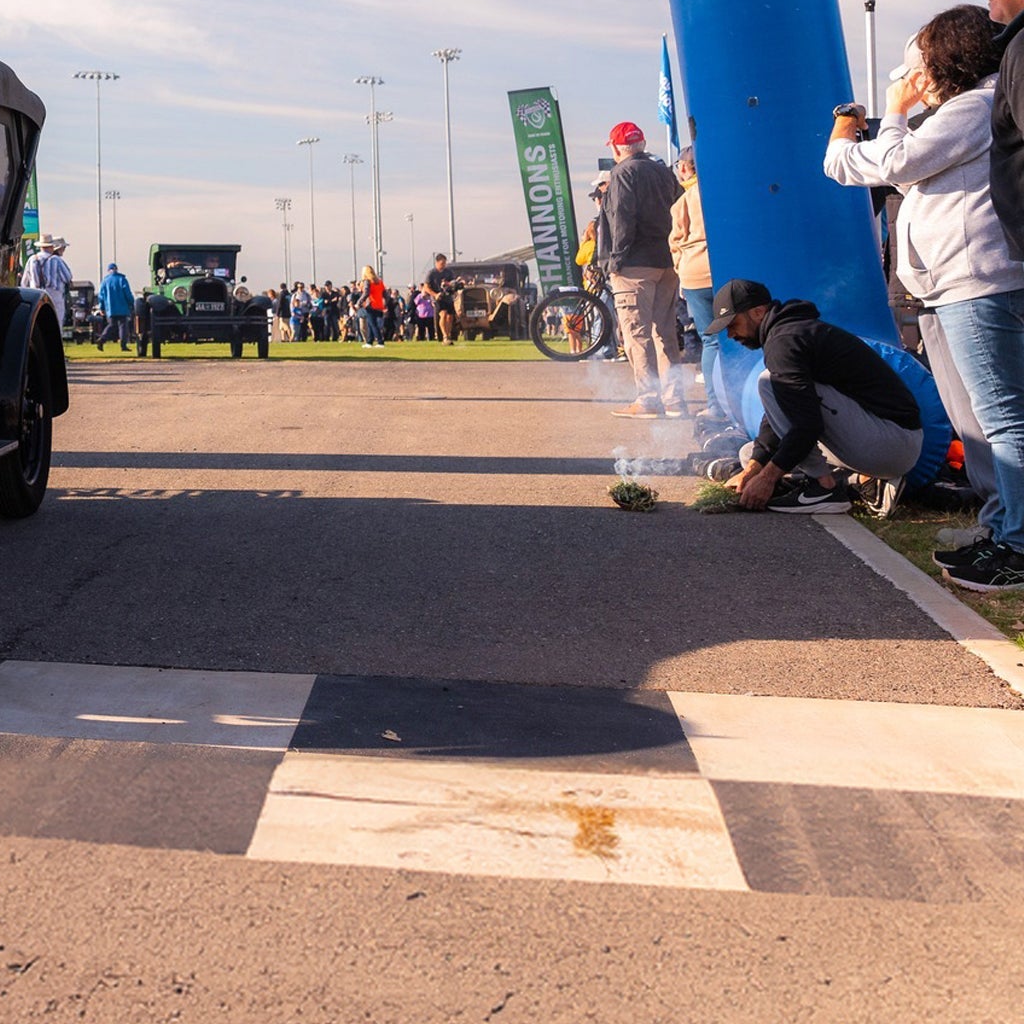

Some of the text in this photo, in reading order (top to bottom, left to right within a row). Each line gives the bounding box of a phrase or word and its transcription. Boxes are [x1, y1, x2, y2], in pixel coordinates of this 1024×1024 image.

[548, 143, 562, 196] ENTHUSIASTS
[556, 196, 568, 238] MOTORING
[561, 238, 570, 255] FOR
